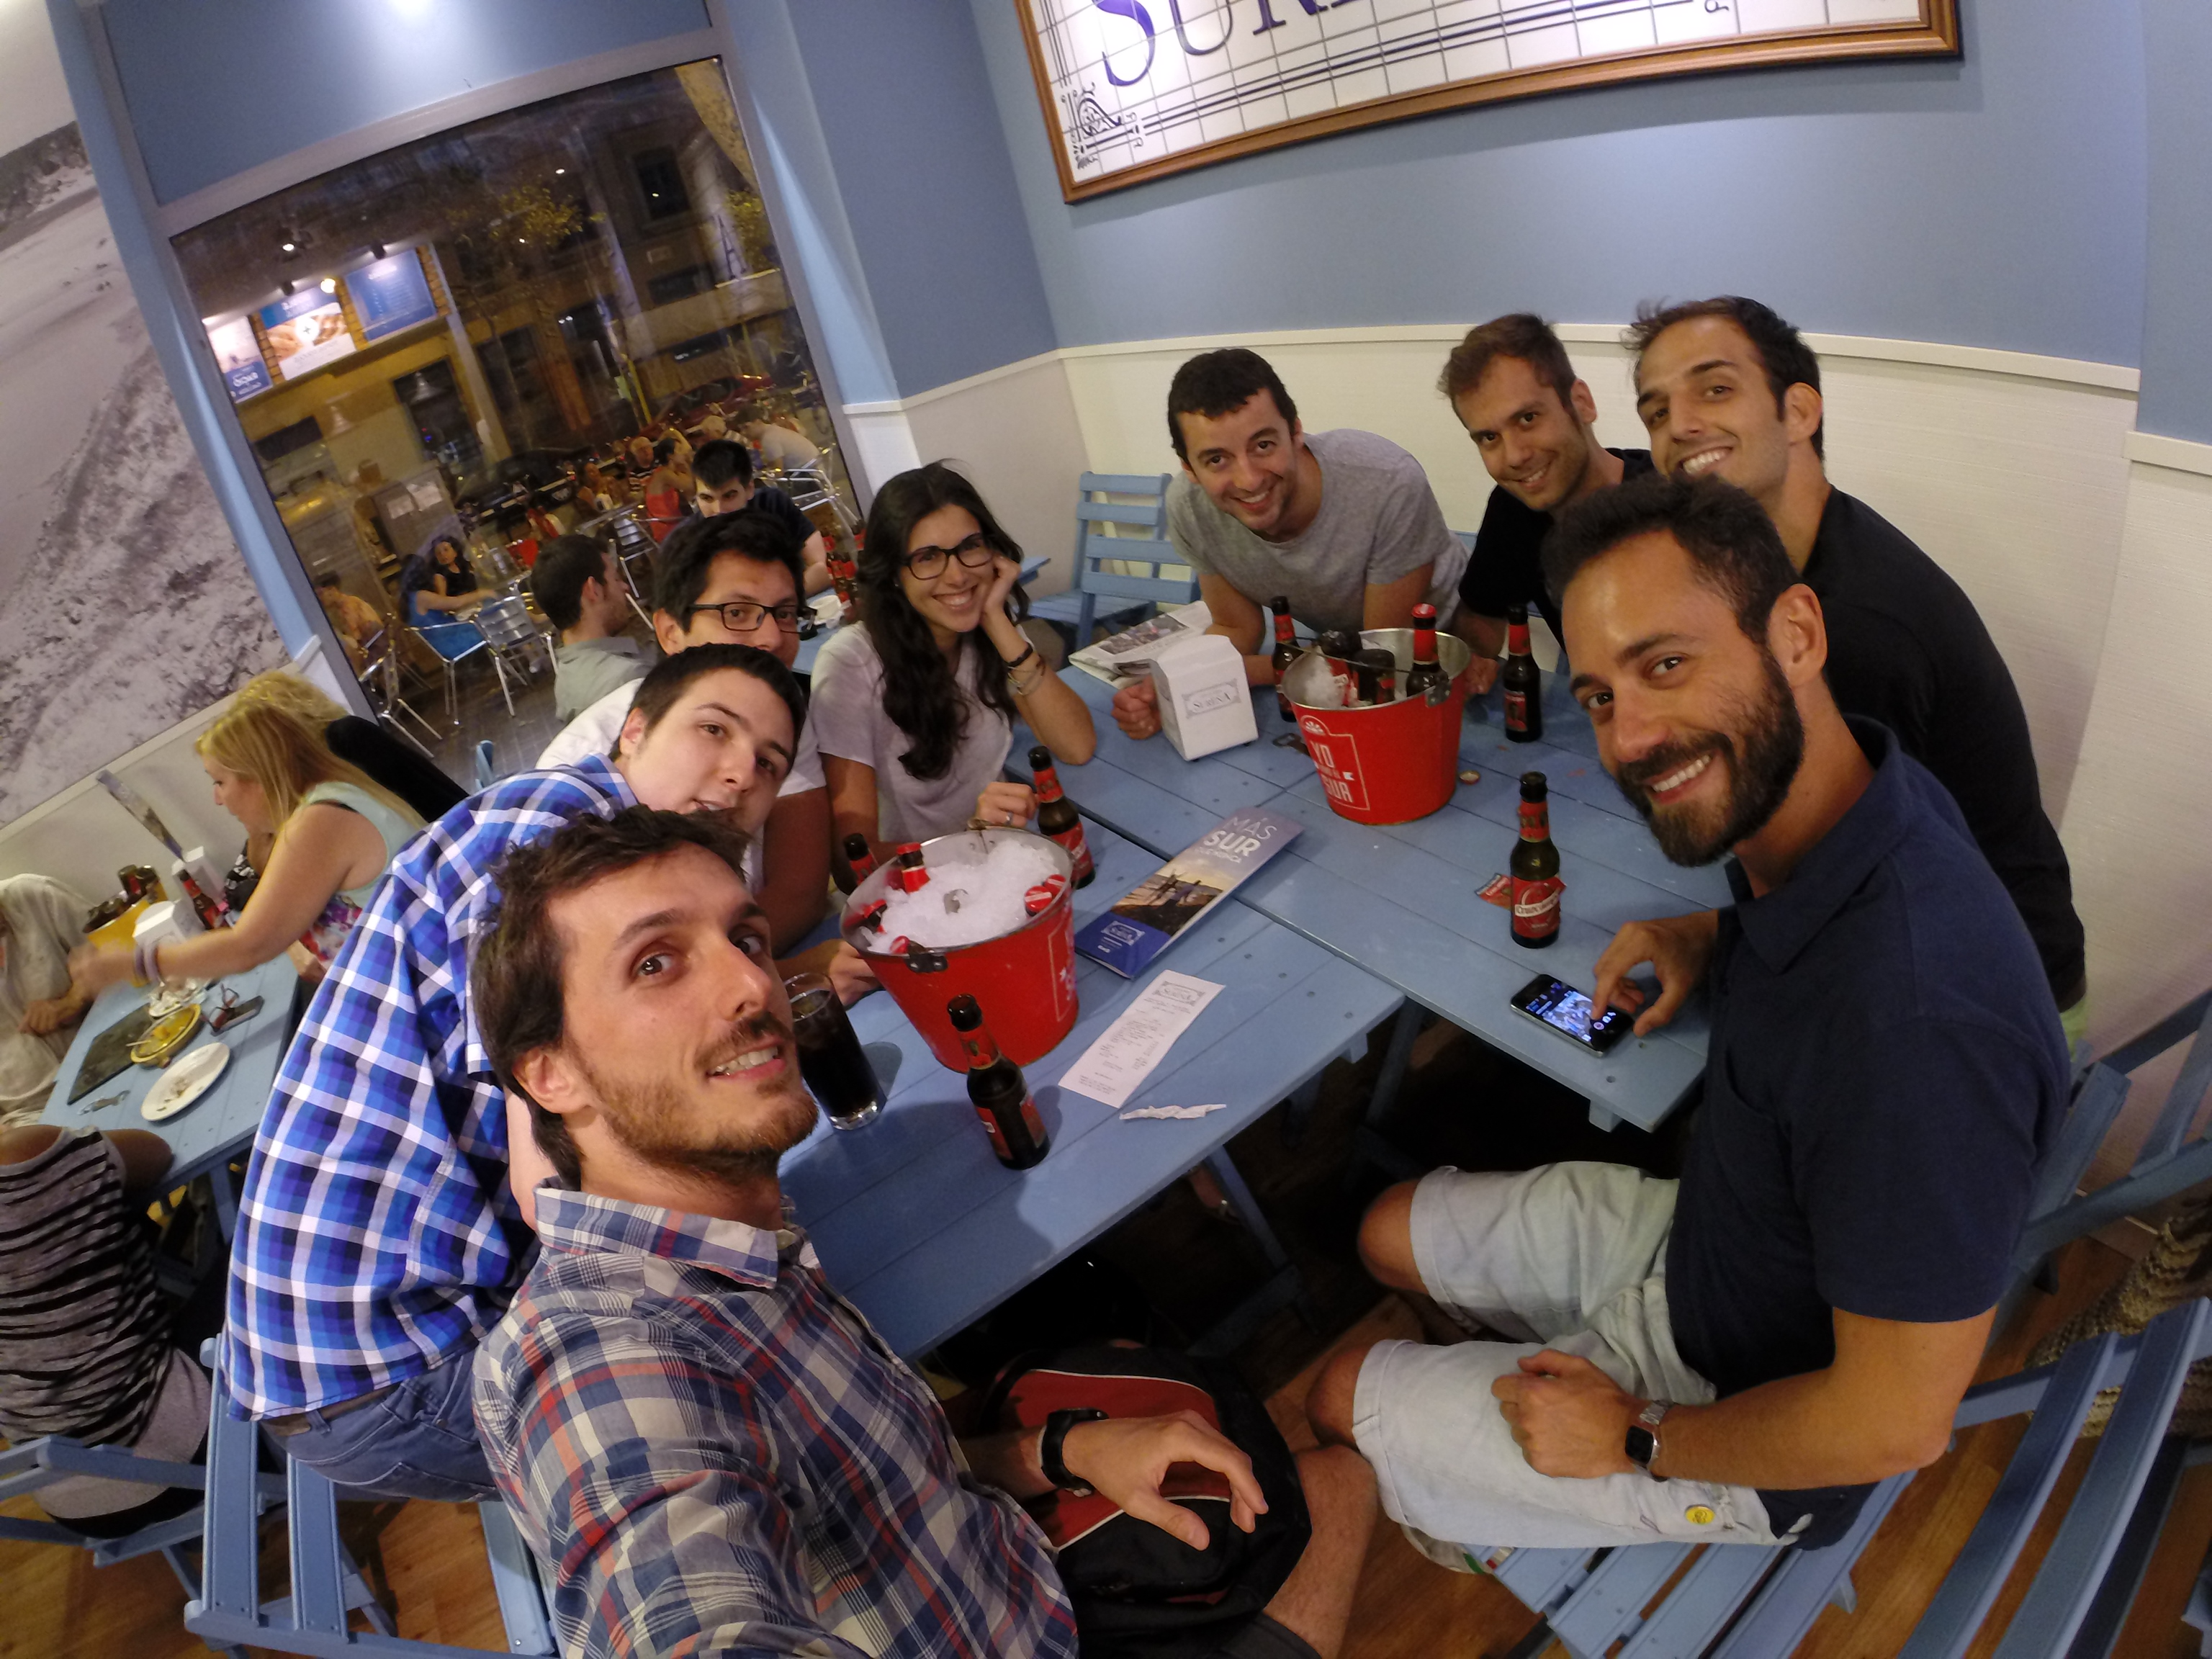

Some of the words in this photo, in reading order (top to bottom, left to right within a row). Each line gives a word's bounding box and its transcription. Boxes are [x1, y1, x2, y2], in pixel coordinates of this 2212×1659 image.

[1322, 778, 1354, 804] SUR
[1223, 817, 1277, 840] MÁS
[1203, 831, 1262, 858] SUR
